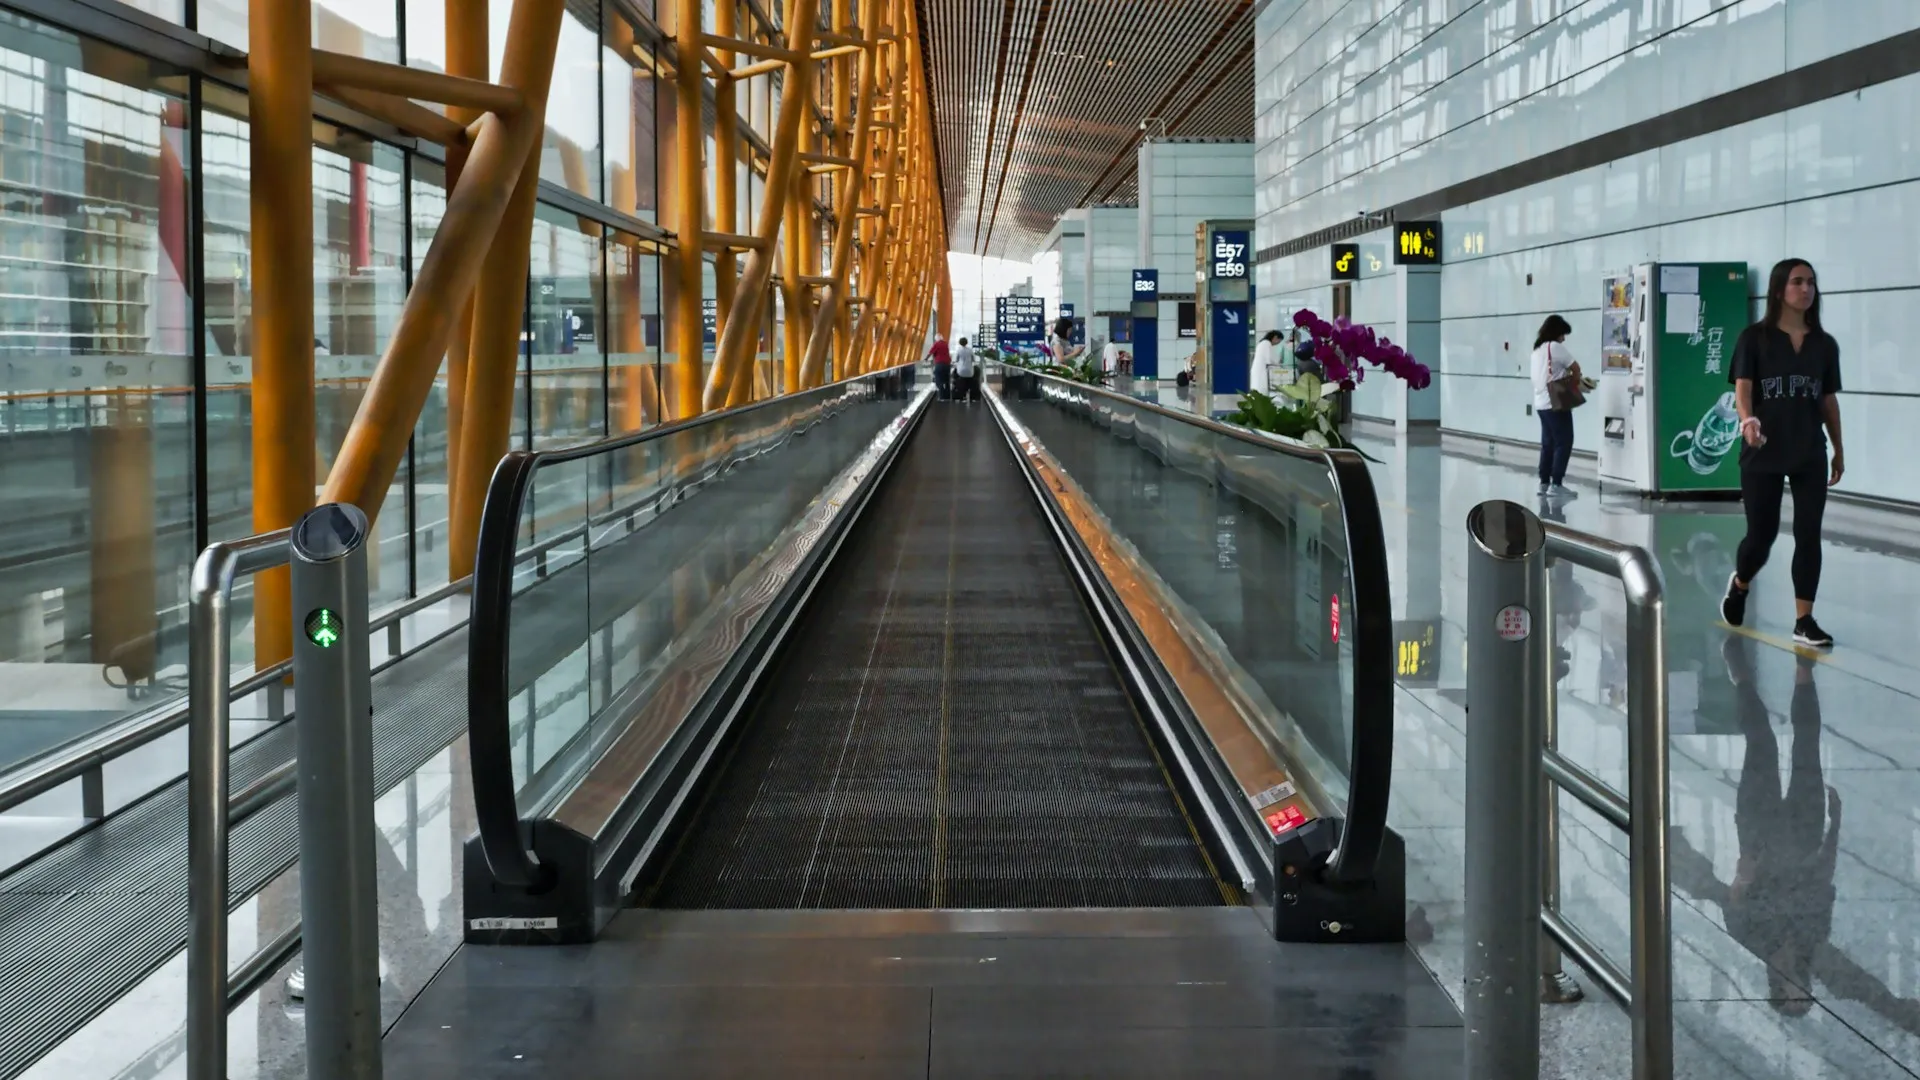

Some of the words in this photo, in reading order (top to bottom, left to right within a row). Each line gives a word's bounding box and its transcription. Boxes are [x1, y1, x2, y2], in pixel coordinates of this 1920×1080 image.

[1215, 243, 1245, 258] E57
[1215, 262, 1245, 277] E59
[1134, 280, 1155, 291] E32
